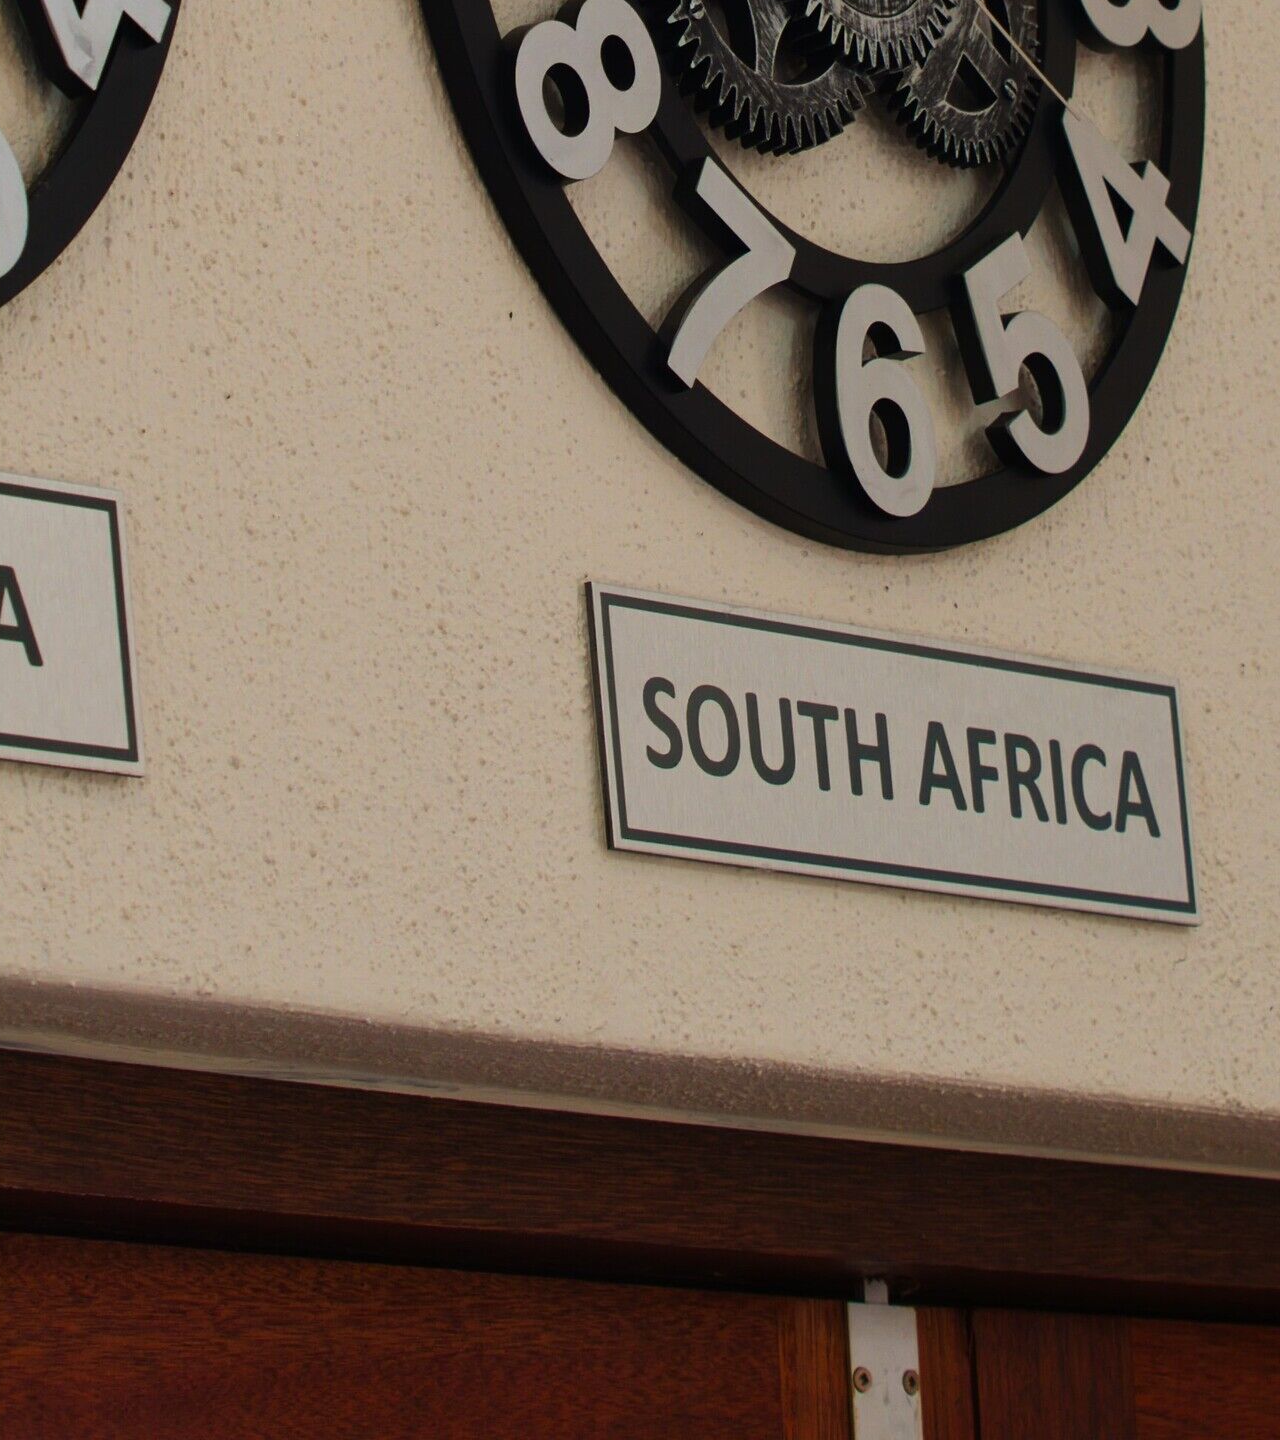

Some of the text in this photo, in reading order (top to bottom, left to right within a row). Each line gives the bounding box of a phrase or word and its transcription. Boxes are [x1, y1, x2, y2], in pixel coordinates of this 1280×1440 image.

[668, 157, 796, 387] 7
[1062, 109, 1191, 306] 4
[835, 283, 934, 516] 6
[963, 232, 1089, 474] 5
[643, 677, 1160, 838] SOUTH AFRICA
